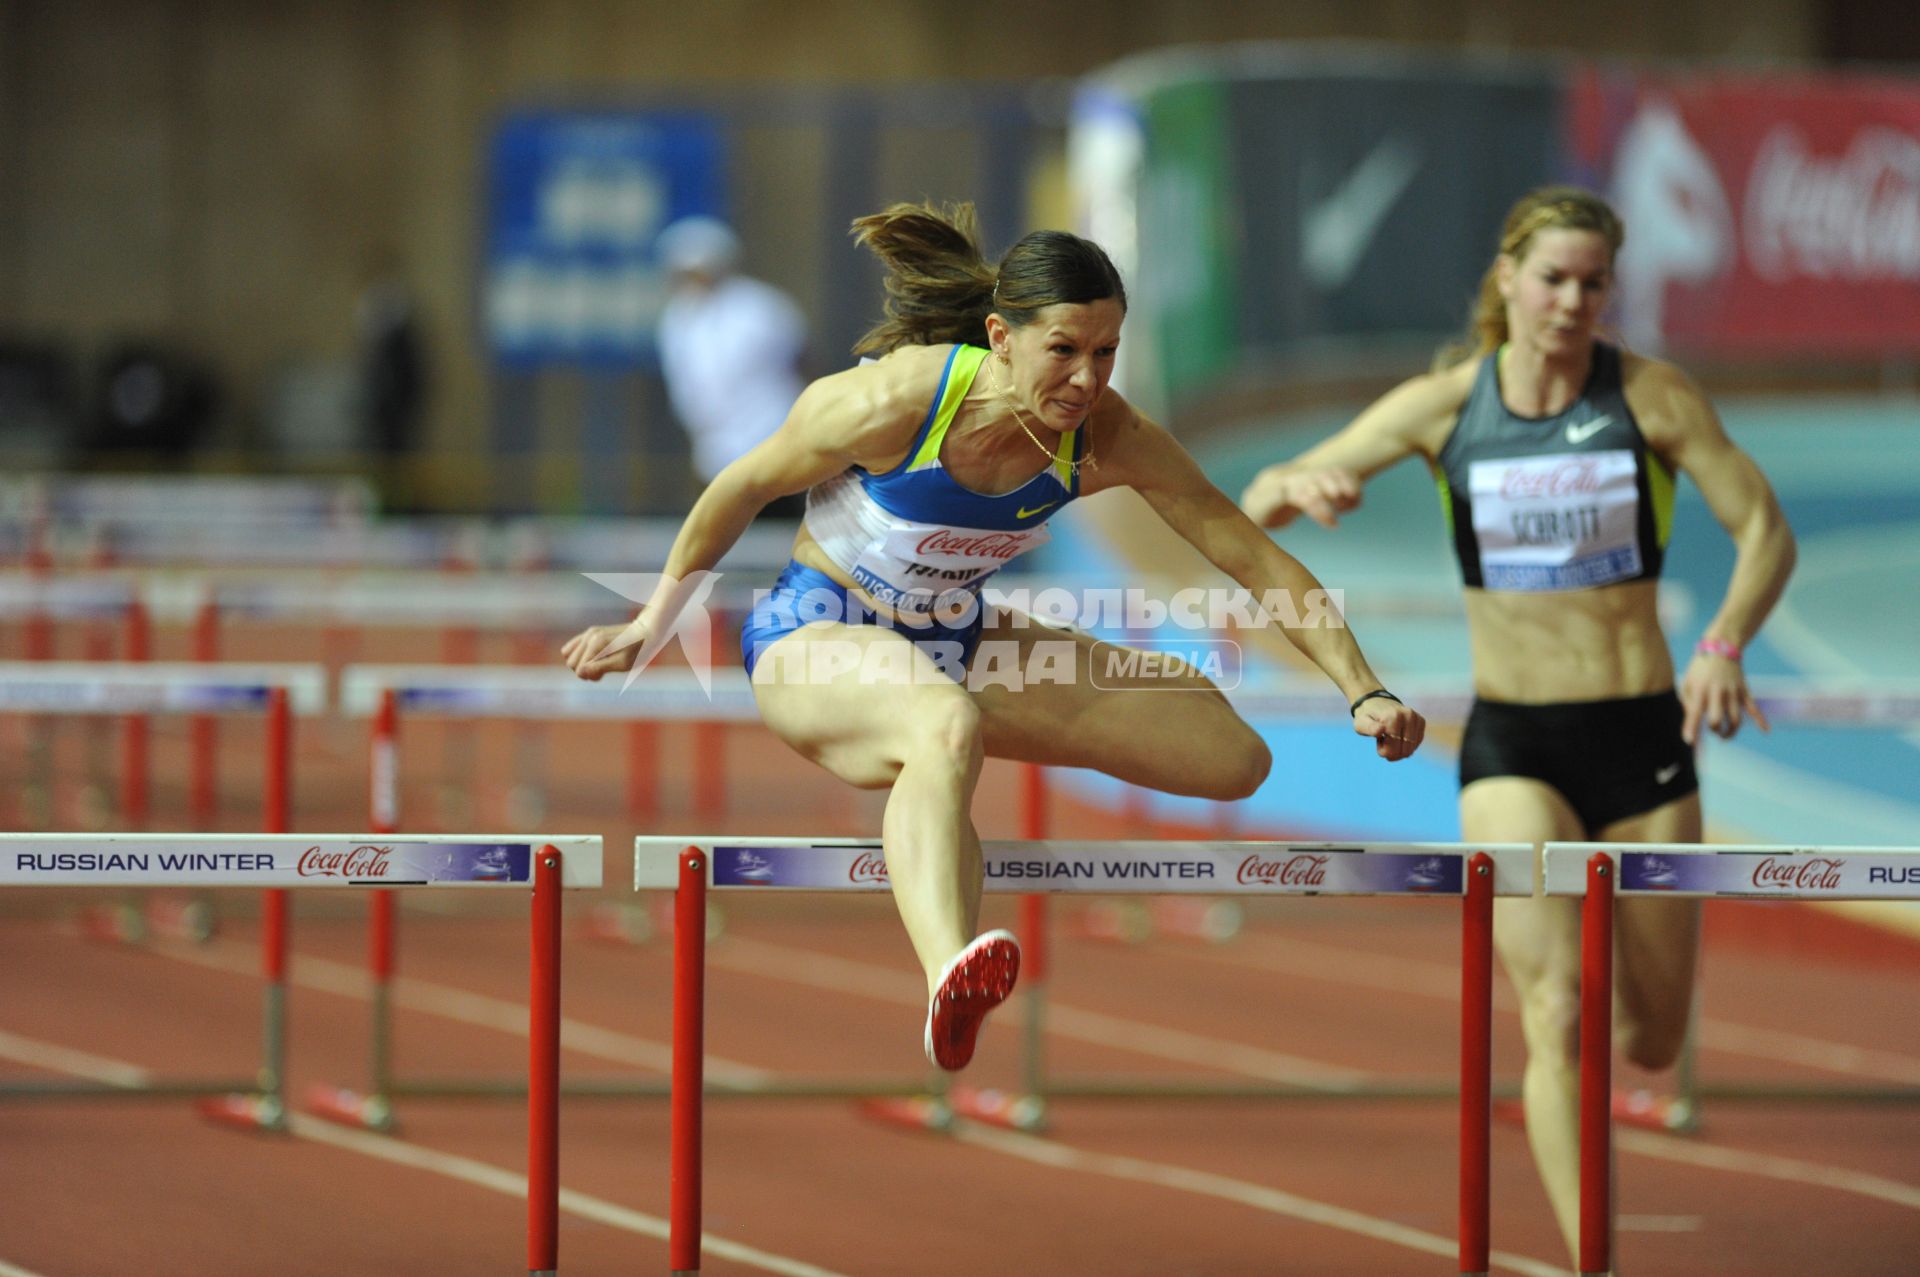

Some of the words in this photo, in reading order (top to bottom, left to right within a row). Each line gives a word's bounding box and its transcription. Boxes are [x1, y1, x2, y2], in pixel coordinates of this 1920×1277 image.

[915, 529, 1029, 559] Coca-Cola
[17, 854, 149, 871] RUSSIAN
[158, 854, 275, 871] WINTER
[297, 845, 390, 877] Coca-Cola
[983, 861, 1094, 878] USSIAN
[1104, 861, 1215, 879] WINTER
[1236, 854, 1328, 886] Coca-Cola
[1752, 857, 1846, 889] Coca-Cola
